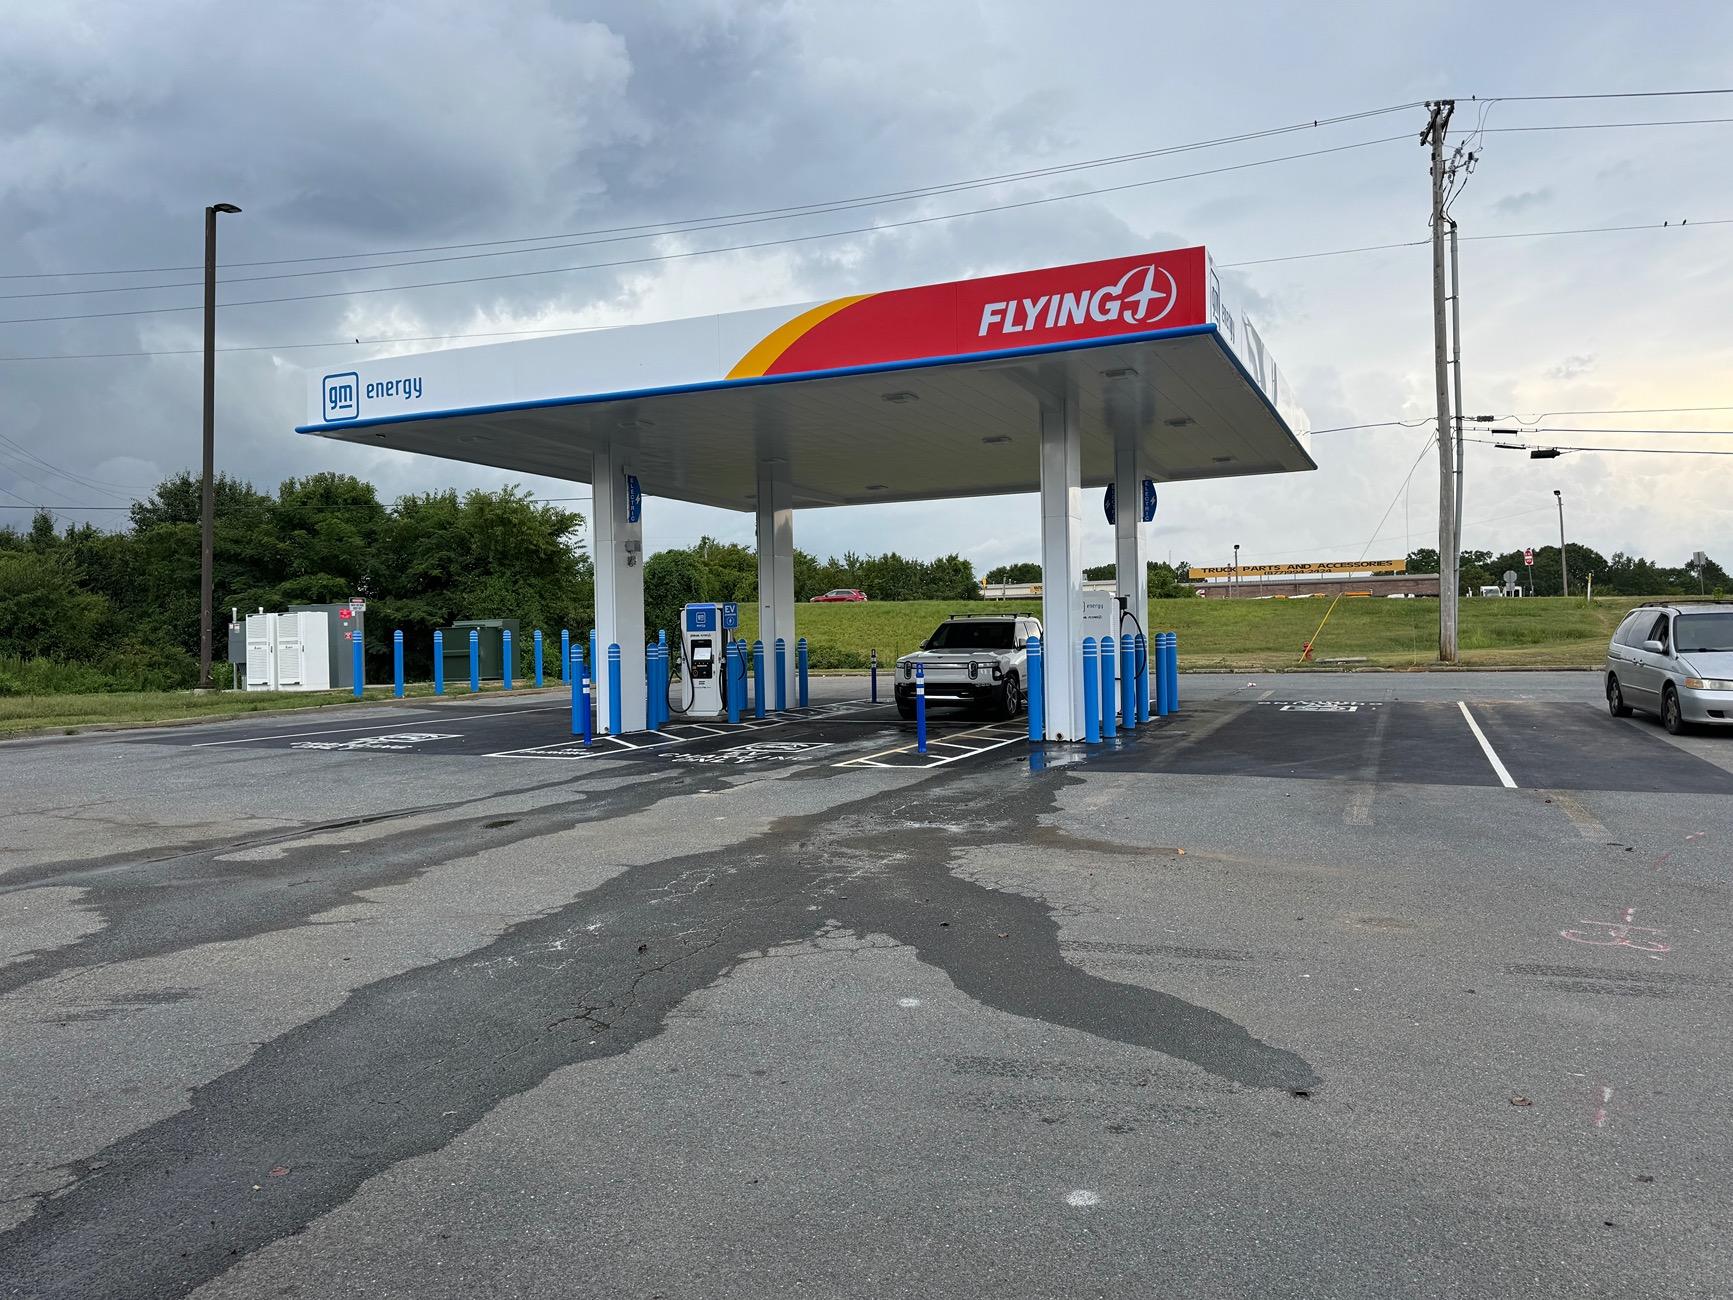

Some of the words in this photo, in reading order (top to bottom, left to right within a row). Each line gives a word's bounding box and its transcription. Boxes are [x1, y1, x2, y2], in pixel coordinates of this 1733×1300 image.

[978, 284, 1122, 337] FLYING
[328, 384, 353, 411] gm
[366, 377, 423, 400] energy
[1242, 564, 1281, 572] PARTS
[1317, 560, 1393, 569] ACCESSORIES
[724, 605, 735, 613] EV
